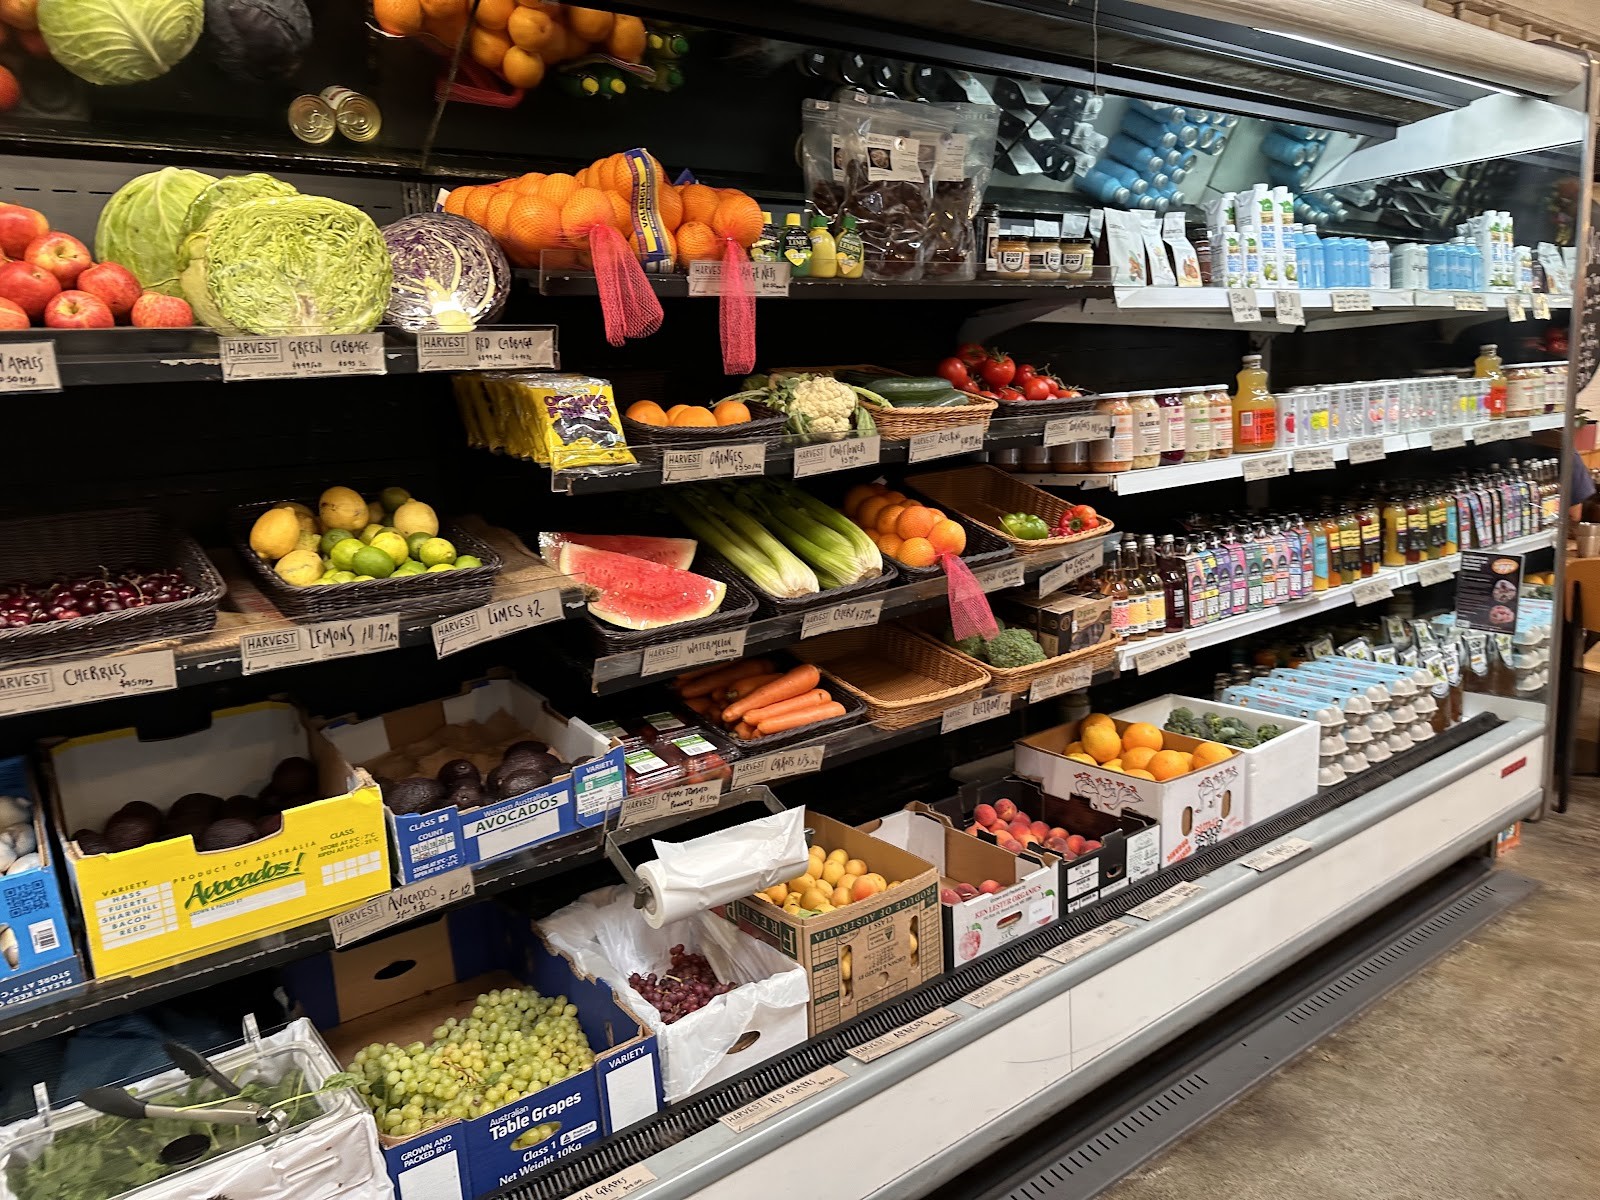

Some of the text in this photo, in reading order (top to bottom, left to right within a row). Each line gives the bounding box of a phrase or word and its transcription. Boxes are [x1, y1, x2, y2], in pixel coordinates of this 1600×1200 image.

[640, 182, 648, 227] VALENCIA
[840, 242, 860, 252] LEMON
[228, 339, 370, 359] HARVEST GREEN CABBAGE
[424, 337, 533, 351] HARVEST RED CABBAGE
[8, 356, 43, 374] APPLES
[669, 449, 743, 469] HARVEST ORANGES
[798, 448, 824, 460] HARVEST
[437, 614, 476, 637] HARVEST
[806, 612, 828, 624] HARVEST
[248, 632, 295, 648] HARVEST
[309, 624, 354, 648] LEMONS
[648, 637, 731, 658] HARVEST WATERMELON
[0, 663, 127, 689] ARVEST CHERRIES
[586, 759, 614, 774] VARIETY
[736, 761, 764, 773] HARVEST
[483, 791, 549, 817] Western Australian
[626, 797, 656, 811] HARVEST
[476, 796, 558, 833] AVOCADOS
[330, 828, 354, 839] CLASS
[409, 819, 435, 832] CLASS
[418, 828, 444, 841] COUNT
[320, 843, 338, 851] STORE
[173, 841, 317, 884] PRODUCT OF AUSTRALIA
[102, 879, 149, 897] VARIETY
[112, 890, 142, 903] HASS
[108, 897, 148, 913] FUERTE
[337, 886, 436, 927] HARVEST AVOCADOS
[975, 909, 988, 919] KEN
[988, 900, 1011, 916] LESTER
[1011, 885, 1041, 905] ORGANICS
[102, 903, 159, 923] SHARWILL
[111, 914, 151, 929] BACON
[814, 885, 937, 942] PRODUCE OF AUSTRALIA
[876, 916, 893, 927] CLASS
[120, 924, 147, 936] REED
[37, 971, 70, 986] STORE
[8, 978, 72, 1003] PLEASE KEEP
[854, 1038, 885, 1054] HARVEST
[609, 1046, 645, 1068] VARIETY
[727, 1101, 762, 1122] HARVEST
[768, 1094, 785, 1104] RED
[786, 1079, 816, 1095] GRAPES
[489, 1092, 581, 1140] Table Grapes
[489, 1106, 529, 1127] Australian
[401, 1134, 452, 1161] GROWN AND
[523, 1141, 556, 1162] Class 1
[403, 1151, 433, 1168] PACKED
[499, 1173, 517, 1186] Net
[595, 1177, 627, 1196] GRAPES
